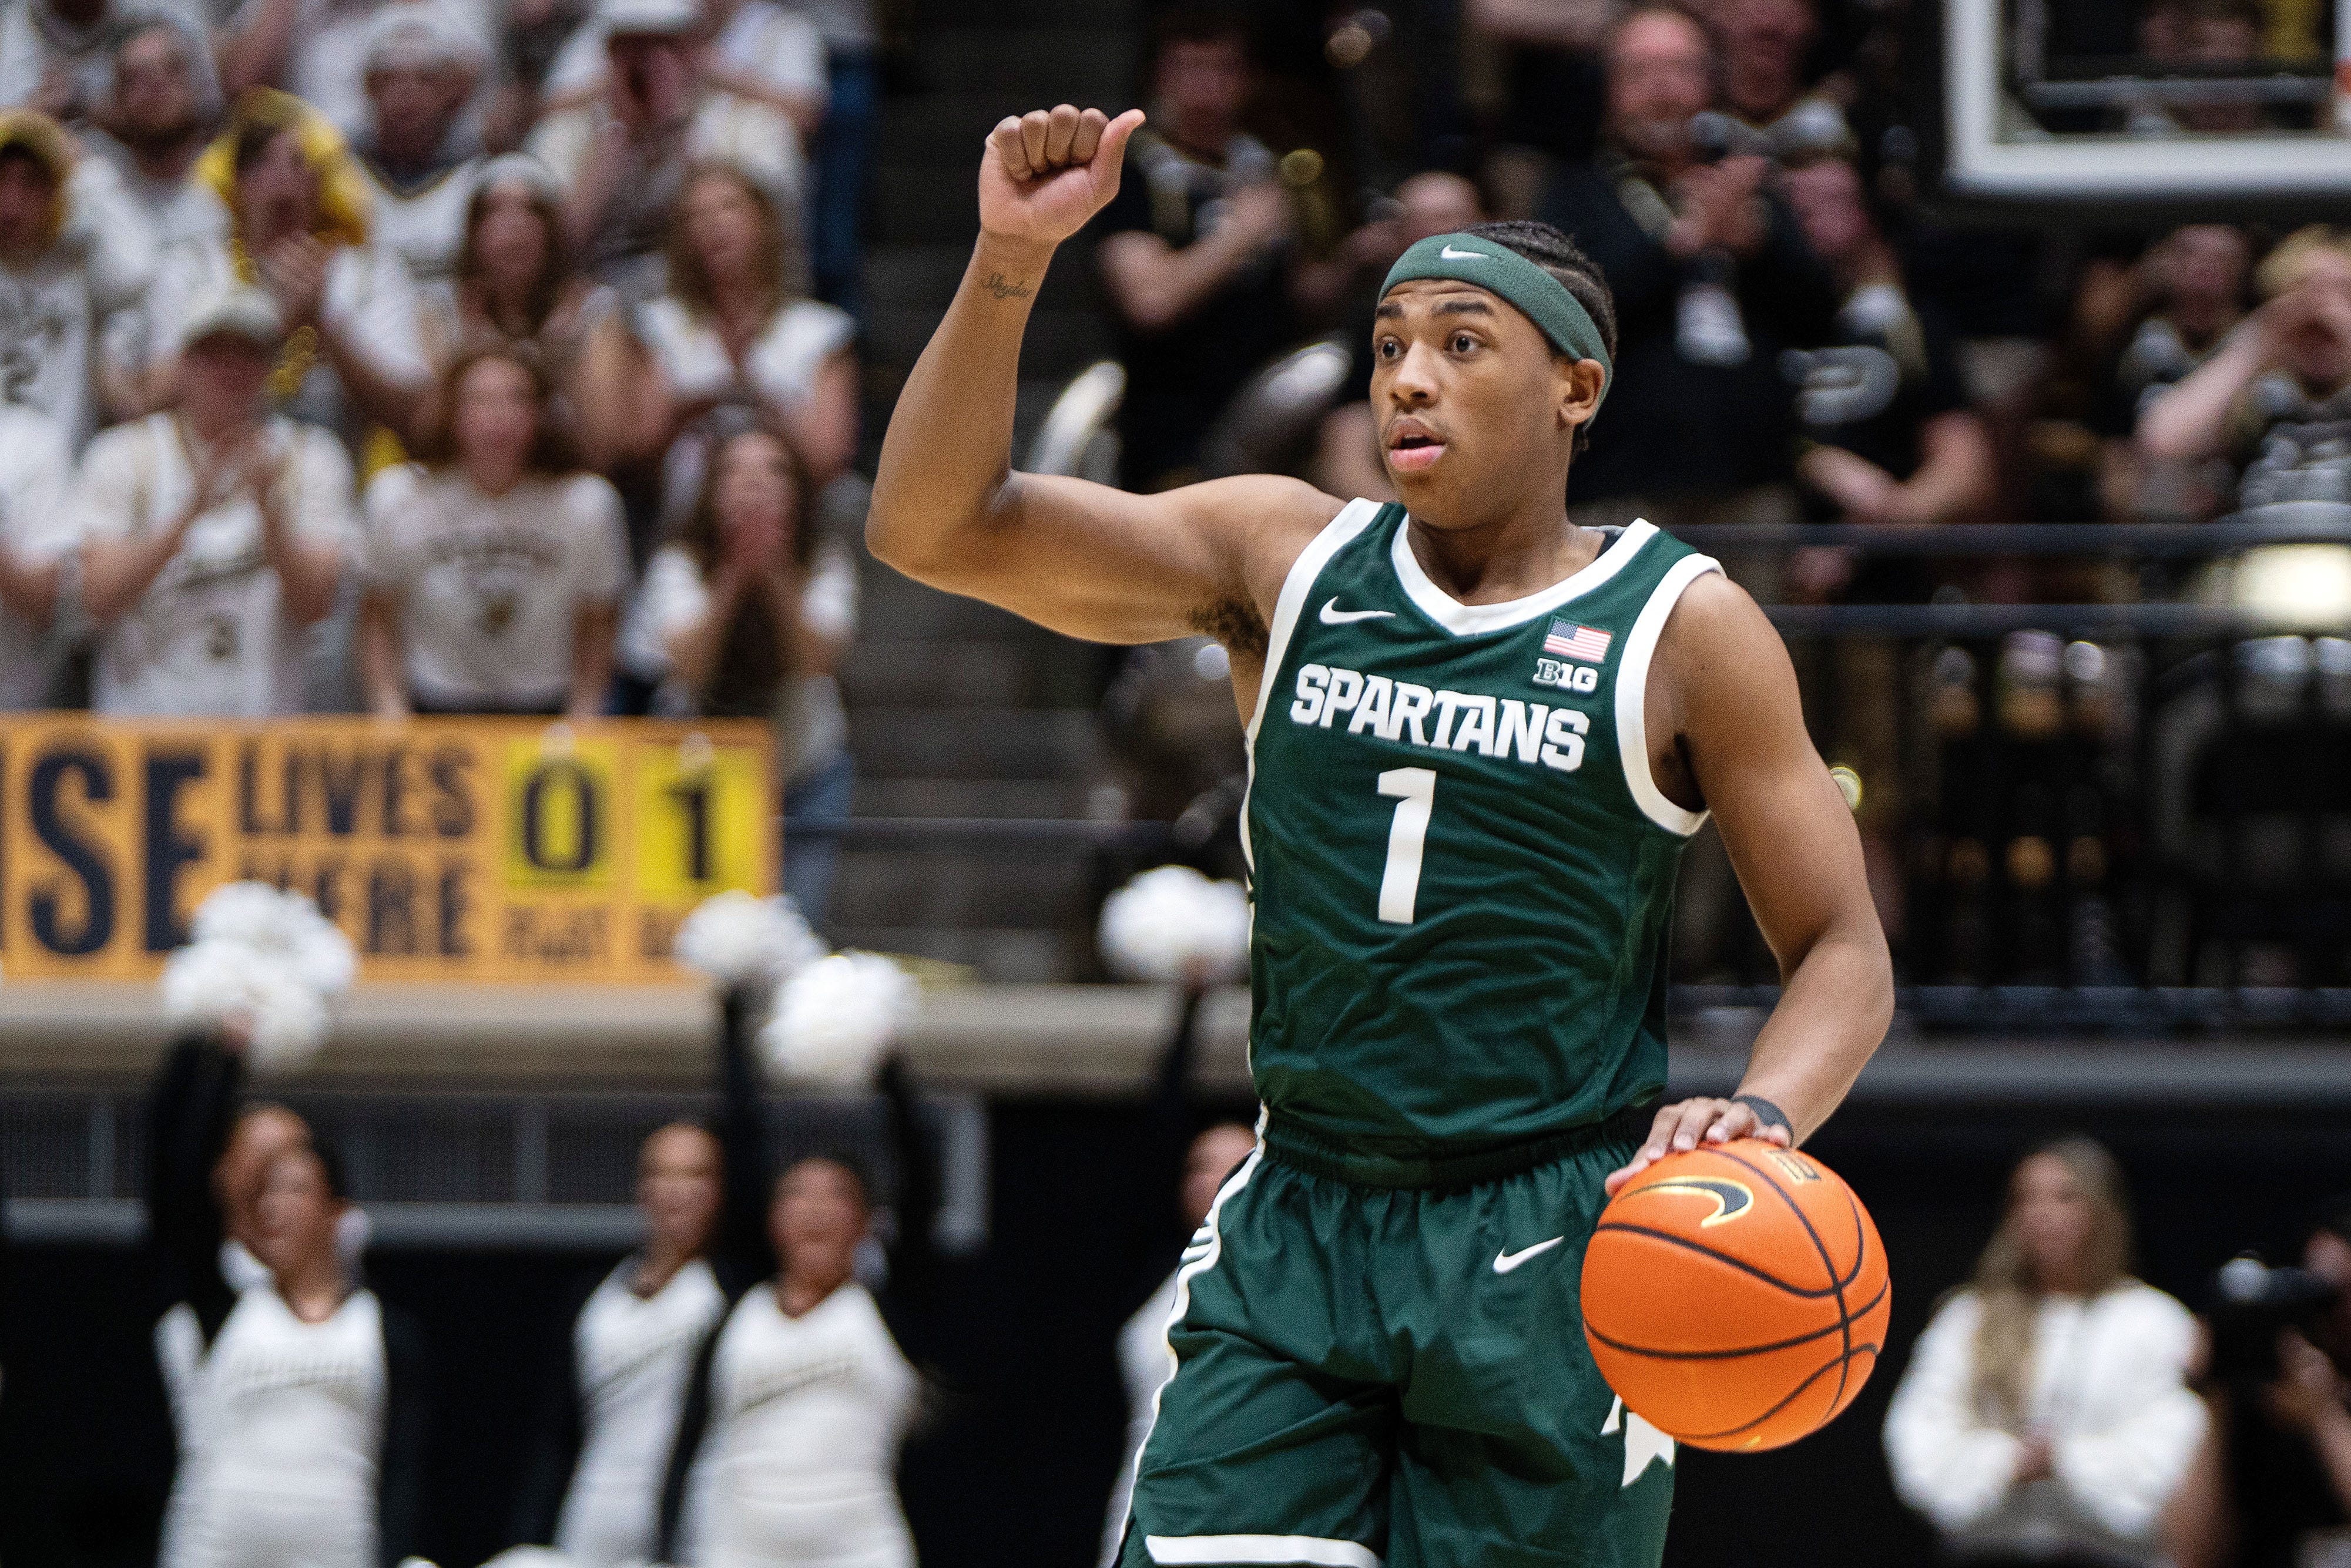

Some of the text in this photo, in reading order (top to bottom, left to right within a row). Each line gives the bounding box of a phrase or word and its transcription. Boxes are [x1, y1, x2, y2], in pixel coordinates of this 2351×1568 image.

[1290, 663, 1591, 773] SPARTANS
[237, 743, 475, 837] LIVES
[0, 745, 210, 956] SE
[1377, 767, 1437, 925] 1
[239, 853, 471, 958] ERE
